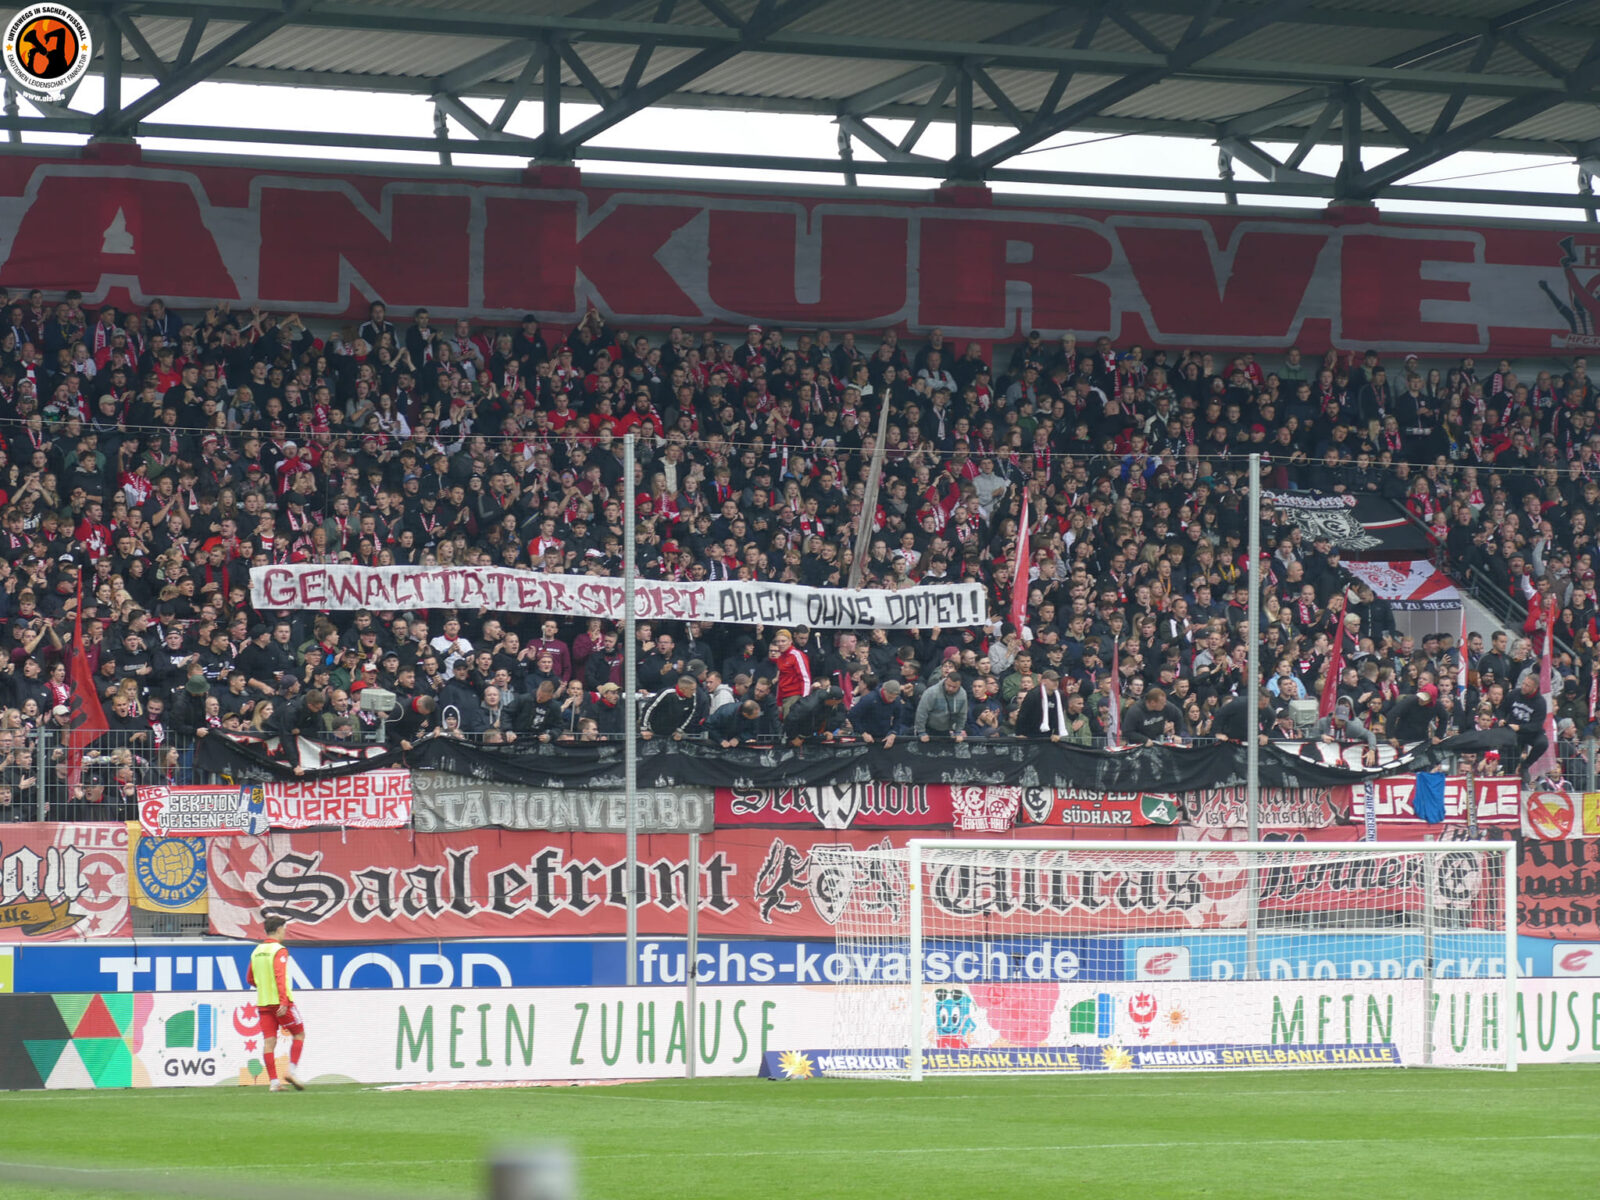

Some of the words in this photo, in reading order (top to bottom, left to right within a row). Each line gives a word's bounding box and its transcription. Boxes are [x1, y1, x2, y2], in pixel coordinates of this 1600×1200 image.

[1405, 602, 1421, 610] ZU
[137, 788, 163, 801] HFC
[168, 794, 238, 812] SEKTION
[158, 812, 249, 829] WEISSENFELS
[1062, 804, 1132, 824] SÜDHARZ
[73, 827, 129, 847] HFC
[255, 845, 740, 925] Saalefront
[639, 943, 1080, 984] fuchs-kovatsch.de
[398, 1003, 535, 1073] MEIN
[569, 999, 776, 1067] ZUHAUSE
[818, 1055, 898, 1071] MERKUR
[1018, 1051, 1081, 1069] HALLE
[1138, 1050, 1218, 1066] MERKUR
[1221, 1048, 1328, 1064] SPIELBANK
[1332, 1046, 1393, 1063] HALLE
[164, 1057, 217, 1078] GWG
